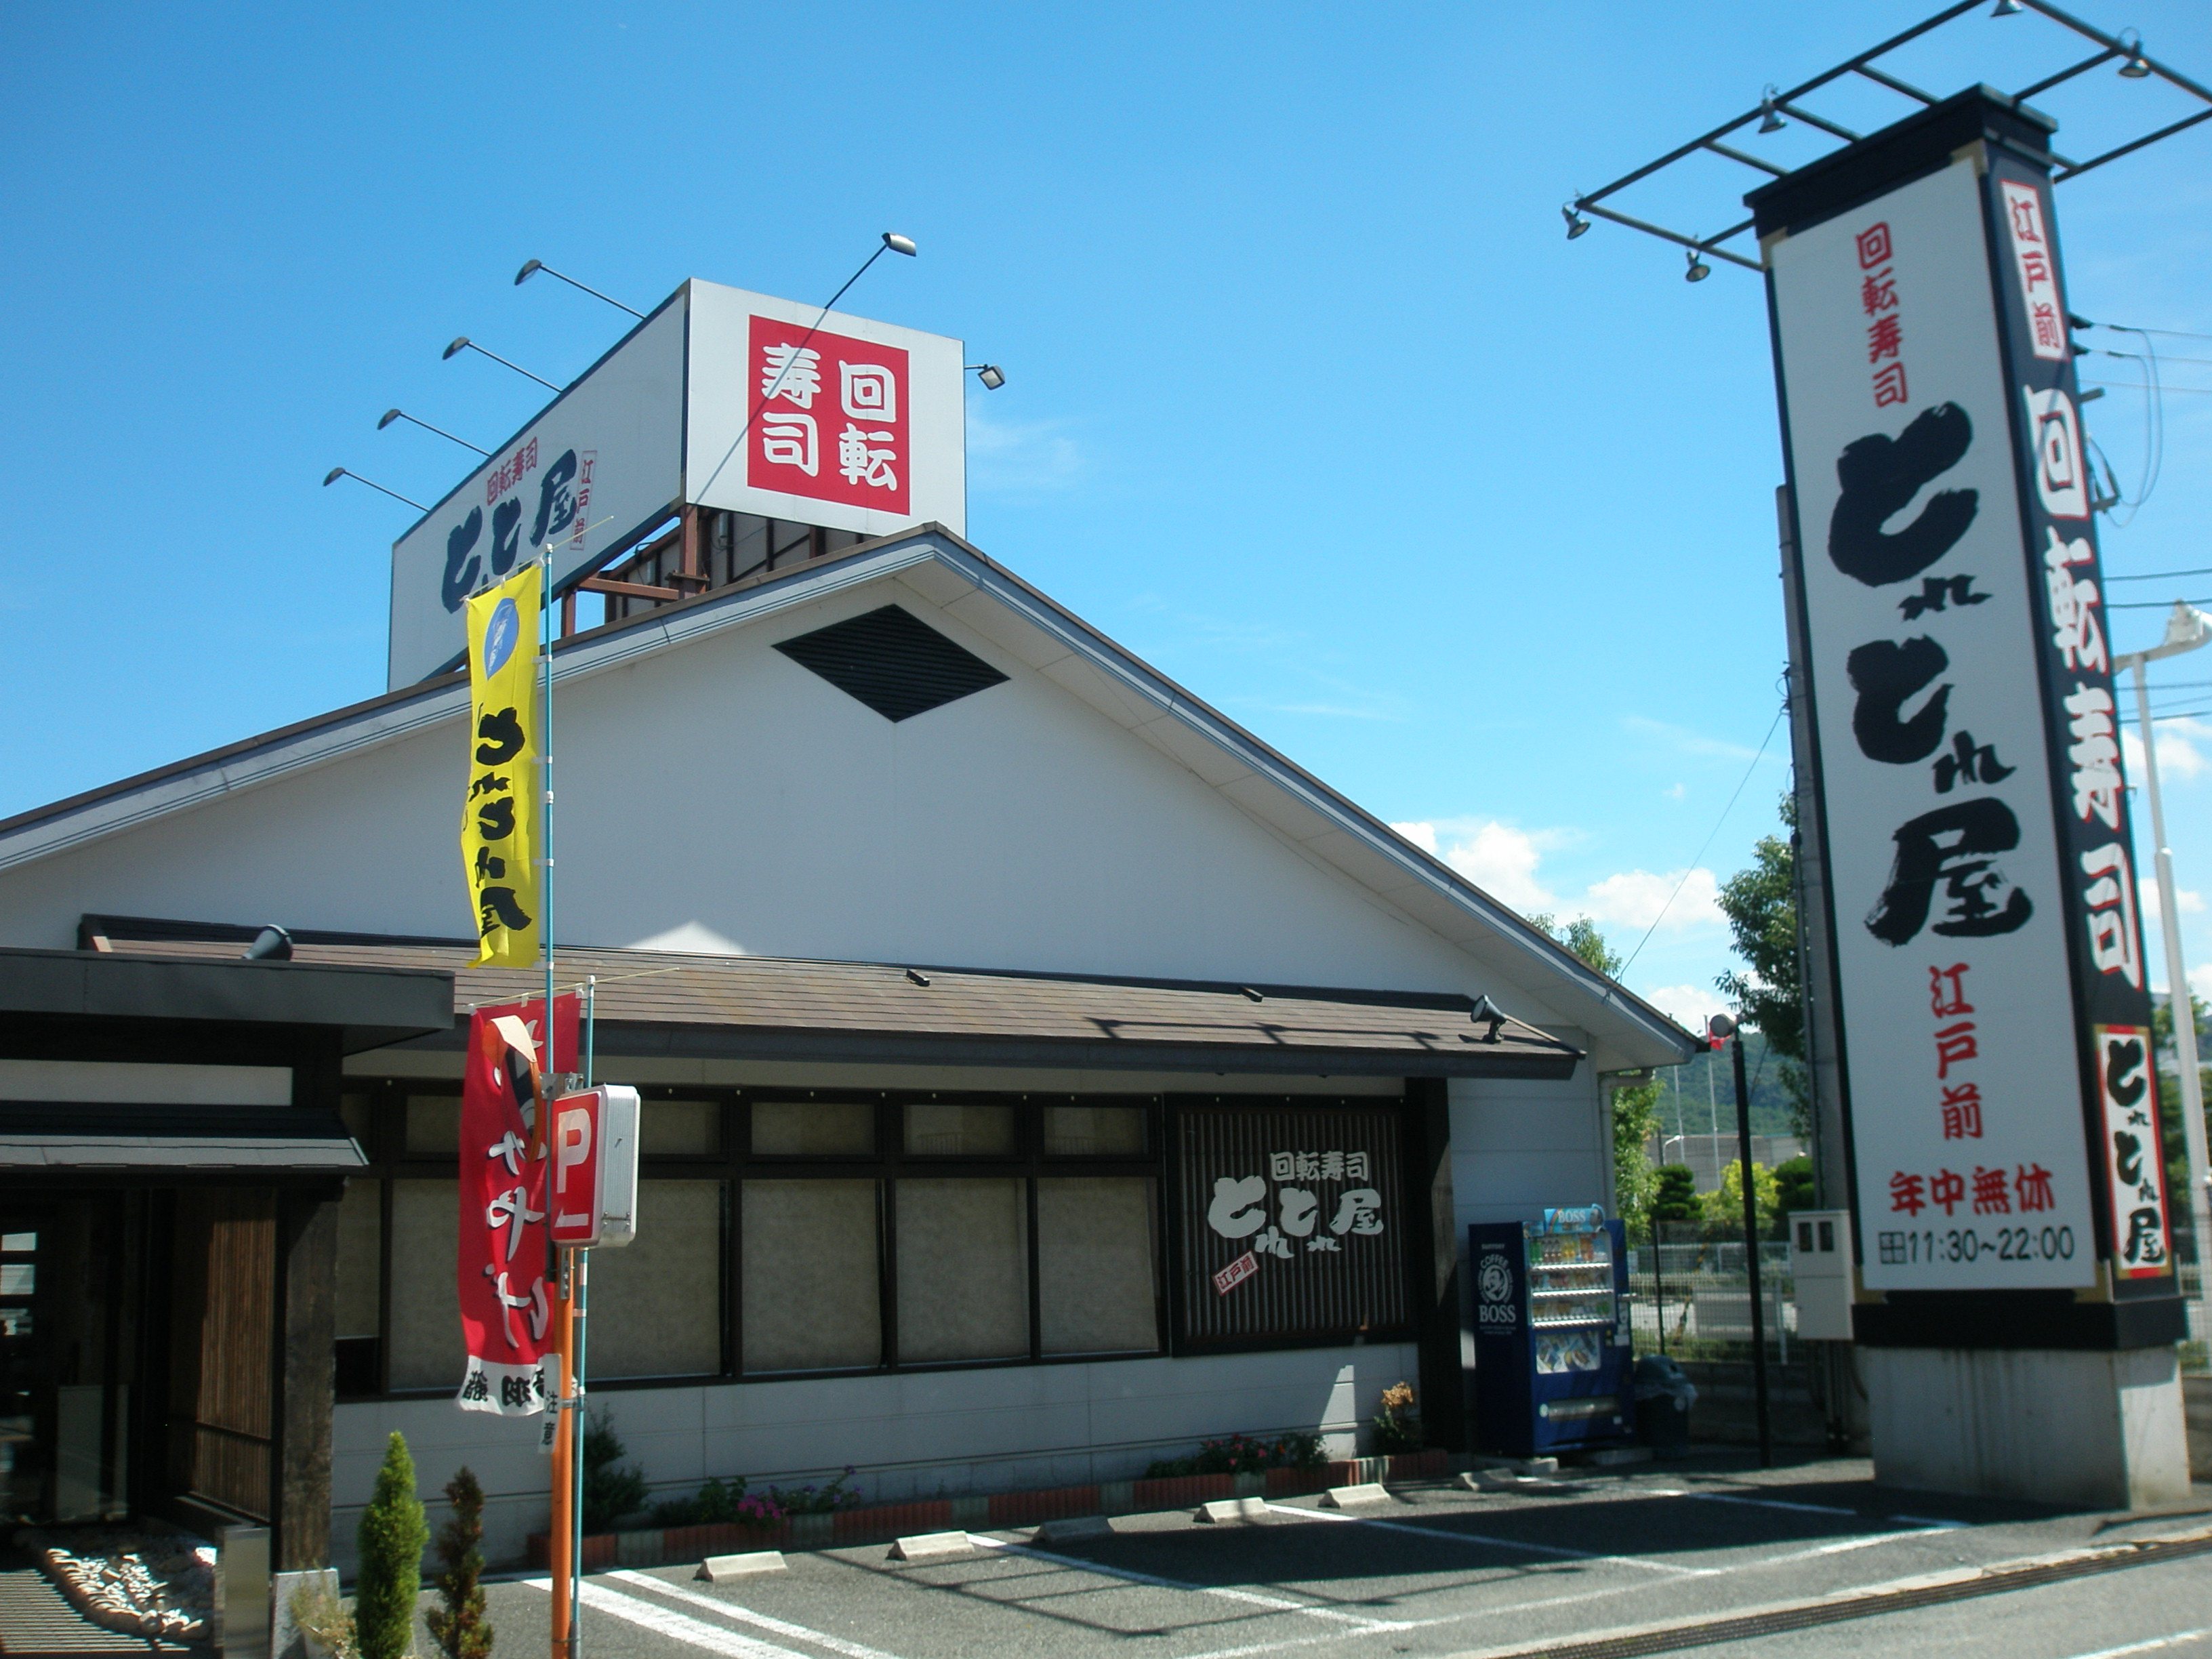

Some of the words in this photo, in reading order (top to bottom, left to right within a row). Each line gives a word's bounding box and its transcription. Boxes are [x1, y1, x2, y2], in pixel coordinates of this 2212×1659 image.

[2010, 197, 2060, 349] 江戸前
[1855, 222, 1908, 408] 回転寿司
[762, 342, 821, 478] 寿司
[838, 360, 898, 492] 回転
[487, 436, 537, 506] 回転寿司
[442, 449, 577, 614] とと屋
[2024, 384, 2146, 991] 回転寿司
[1929, 963, 1983, 1141] 江戸前
[557, 1108, 592, 1193] P
[1269, 1151, 1368, 1181] 回転寿司
[1558, 1209, 1586, 1223] BOSS
[1889, 1164, 2055, 1217] 年中無休
[1217, 1256, 1256, 1289] 江戸前
[1480, 1254, 1509, 1269] COFFEE
[1478, 1304, 1517, 1323] BOSS
[542, 1390, 558, 1446] 注意
